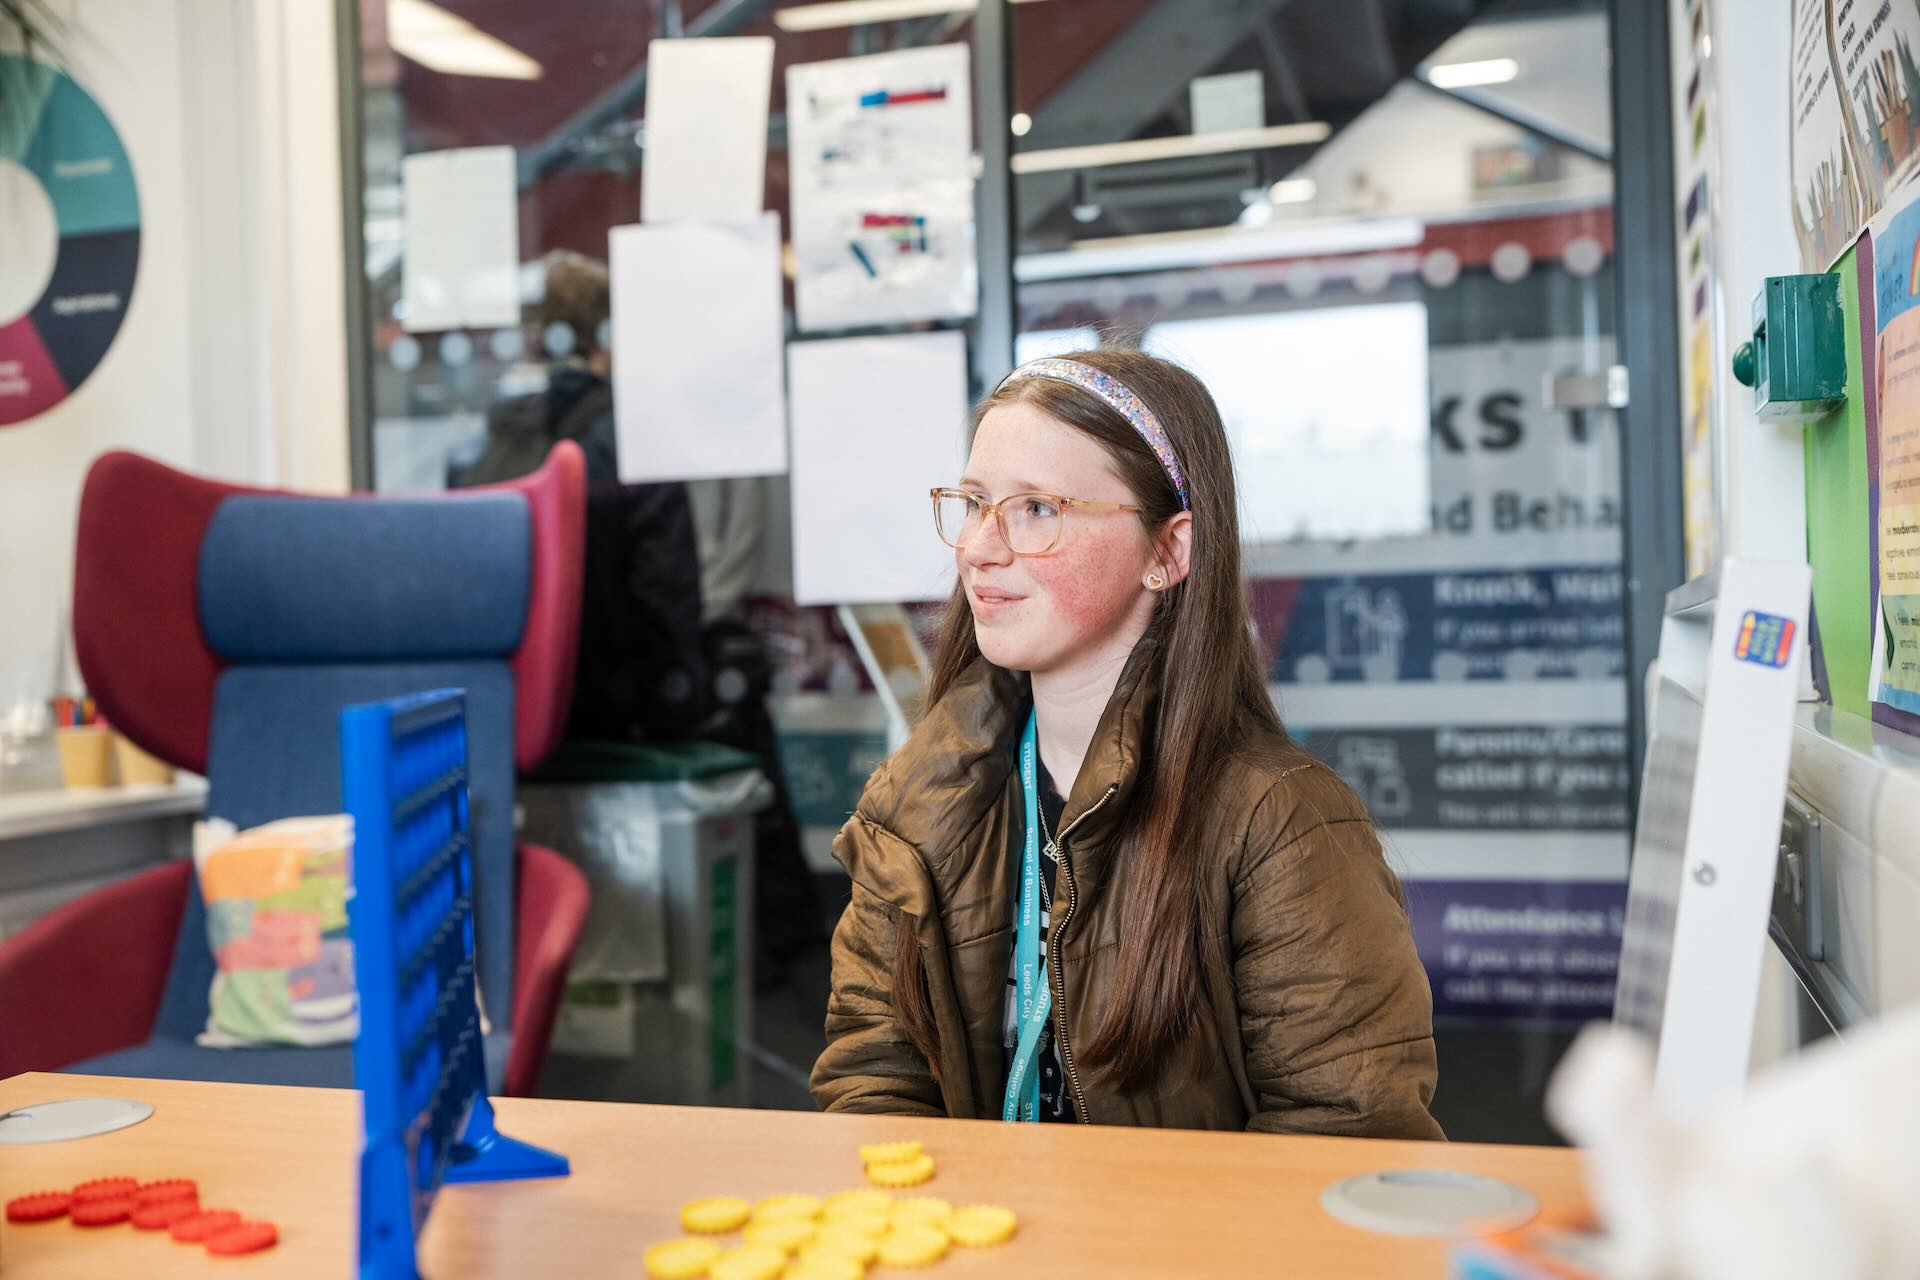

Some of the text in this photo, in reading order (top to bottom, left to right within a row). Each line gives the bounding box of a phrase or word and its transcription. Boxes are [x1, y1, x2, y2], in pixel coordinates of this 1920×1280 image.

[1492, 490, 1620, 534] Beha
[1024, 742, 1032, 790] STUDENT
[1023, 827, 1034, 927] School of Business
[1021, 963, 1033, 1019] Leeds City
[1009, 1058, 1025, 1098] College
